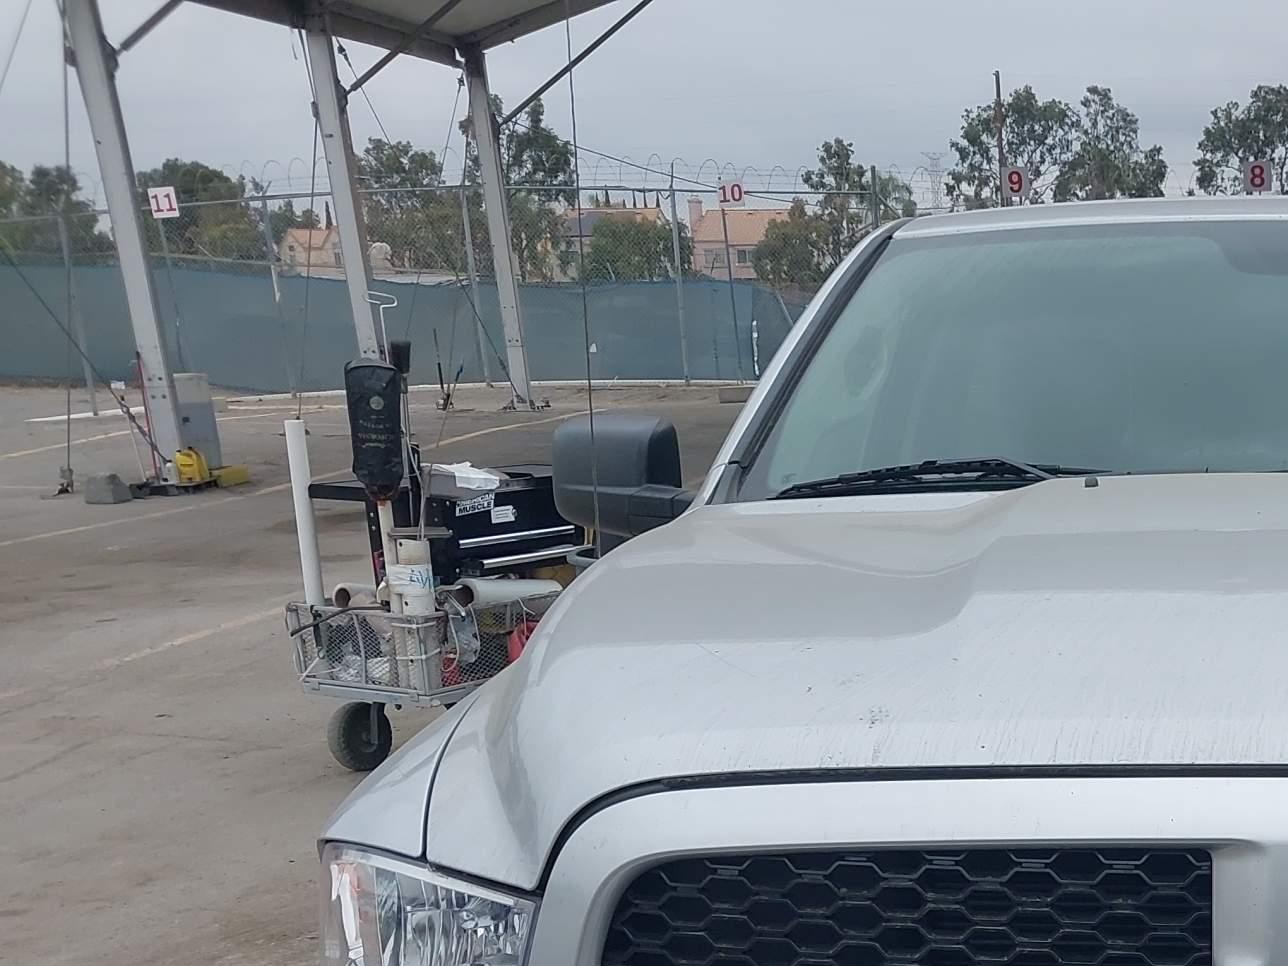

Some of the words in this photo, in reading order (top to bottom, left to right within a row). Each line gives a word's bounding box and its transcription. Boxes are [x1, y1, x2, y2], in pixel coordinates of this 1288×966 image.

[1008, 170, 1023, 193] 9
[1250, 165, 1265, 187] 8
[151, 192, 177, 213] 11
[718, 183, 743, 203] 10
[458, 501, 493, 515] MUSCLE
